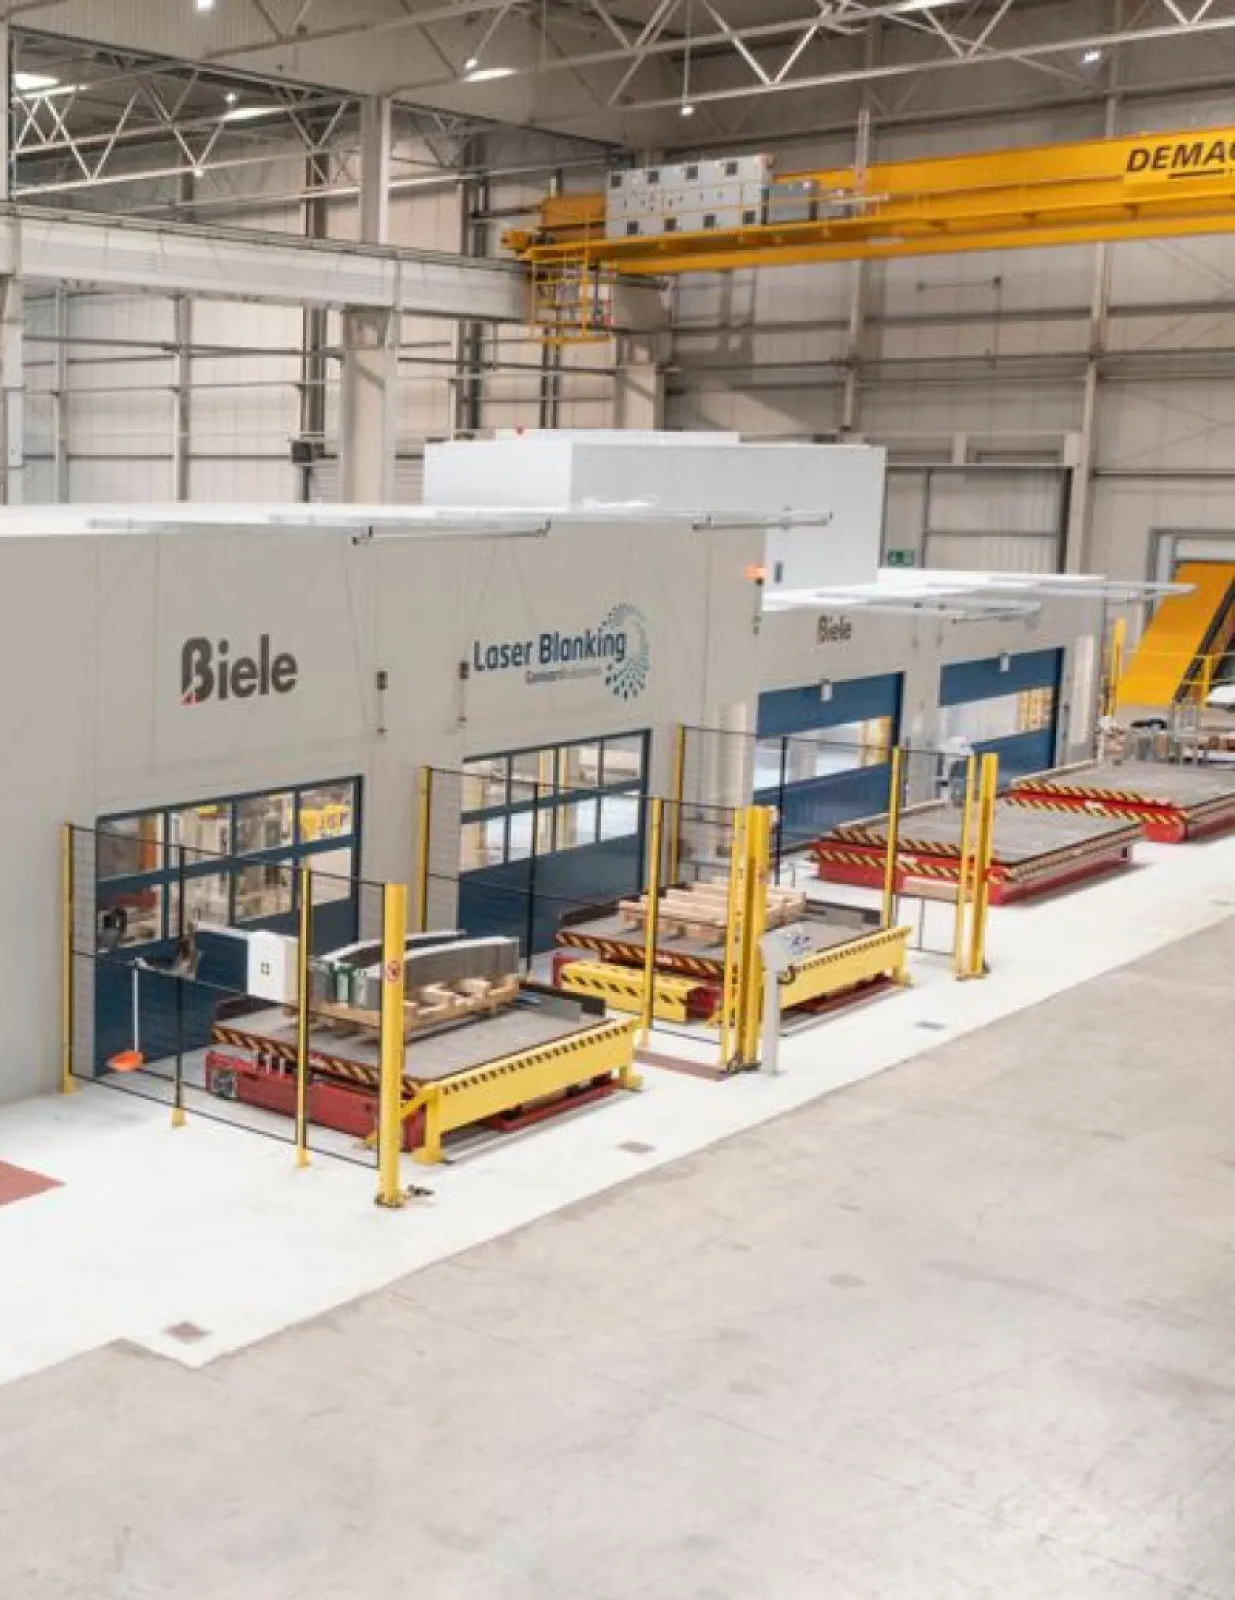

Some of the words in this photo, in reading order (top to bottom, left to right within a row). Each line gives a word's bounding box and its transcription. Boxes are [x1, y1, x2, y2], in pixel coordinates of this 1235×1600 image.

[1126, 140, 1235, 172] DEMA
[181, 634, 298, 705] Biele
[473, 641, 533, 672] Laser
[539, 630, 627, 664] Blanking
